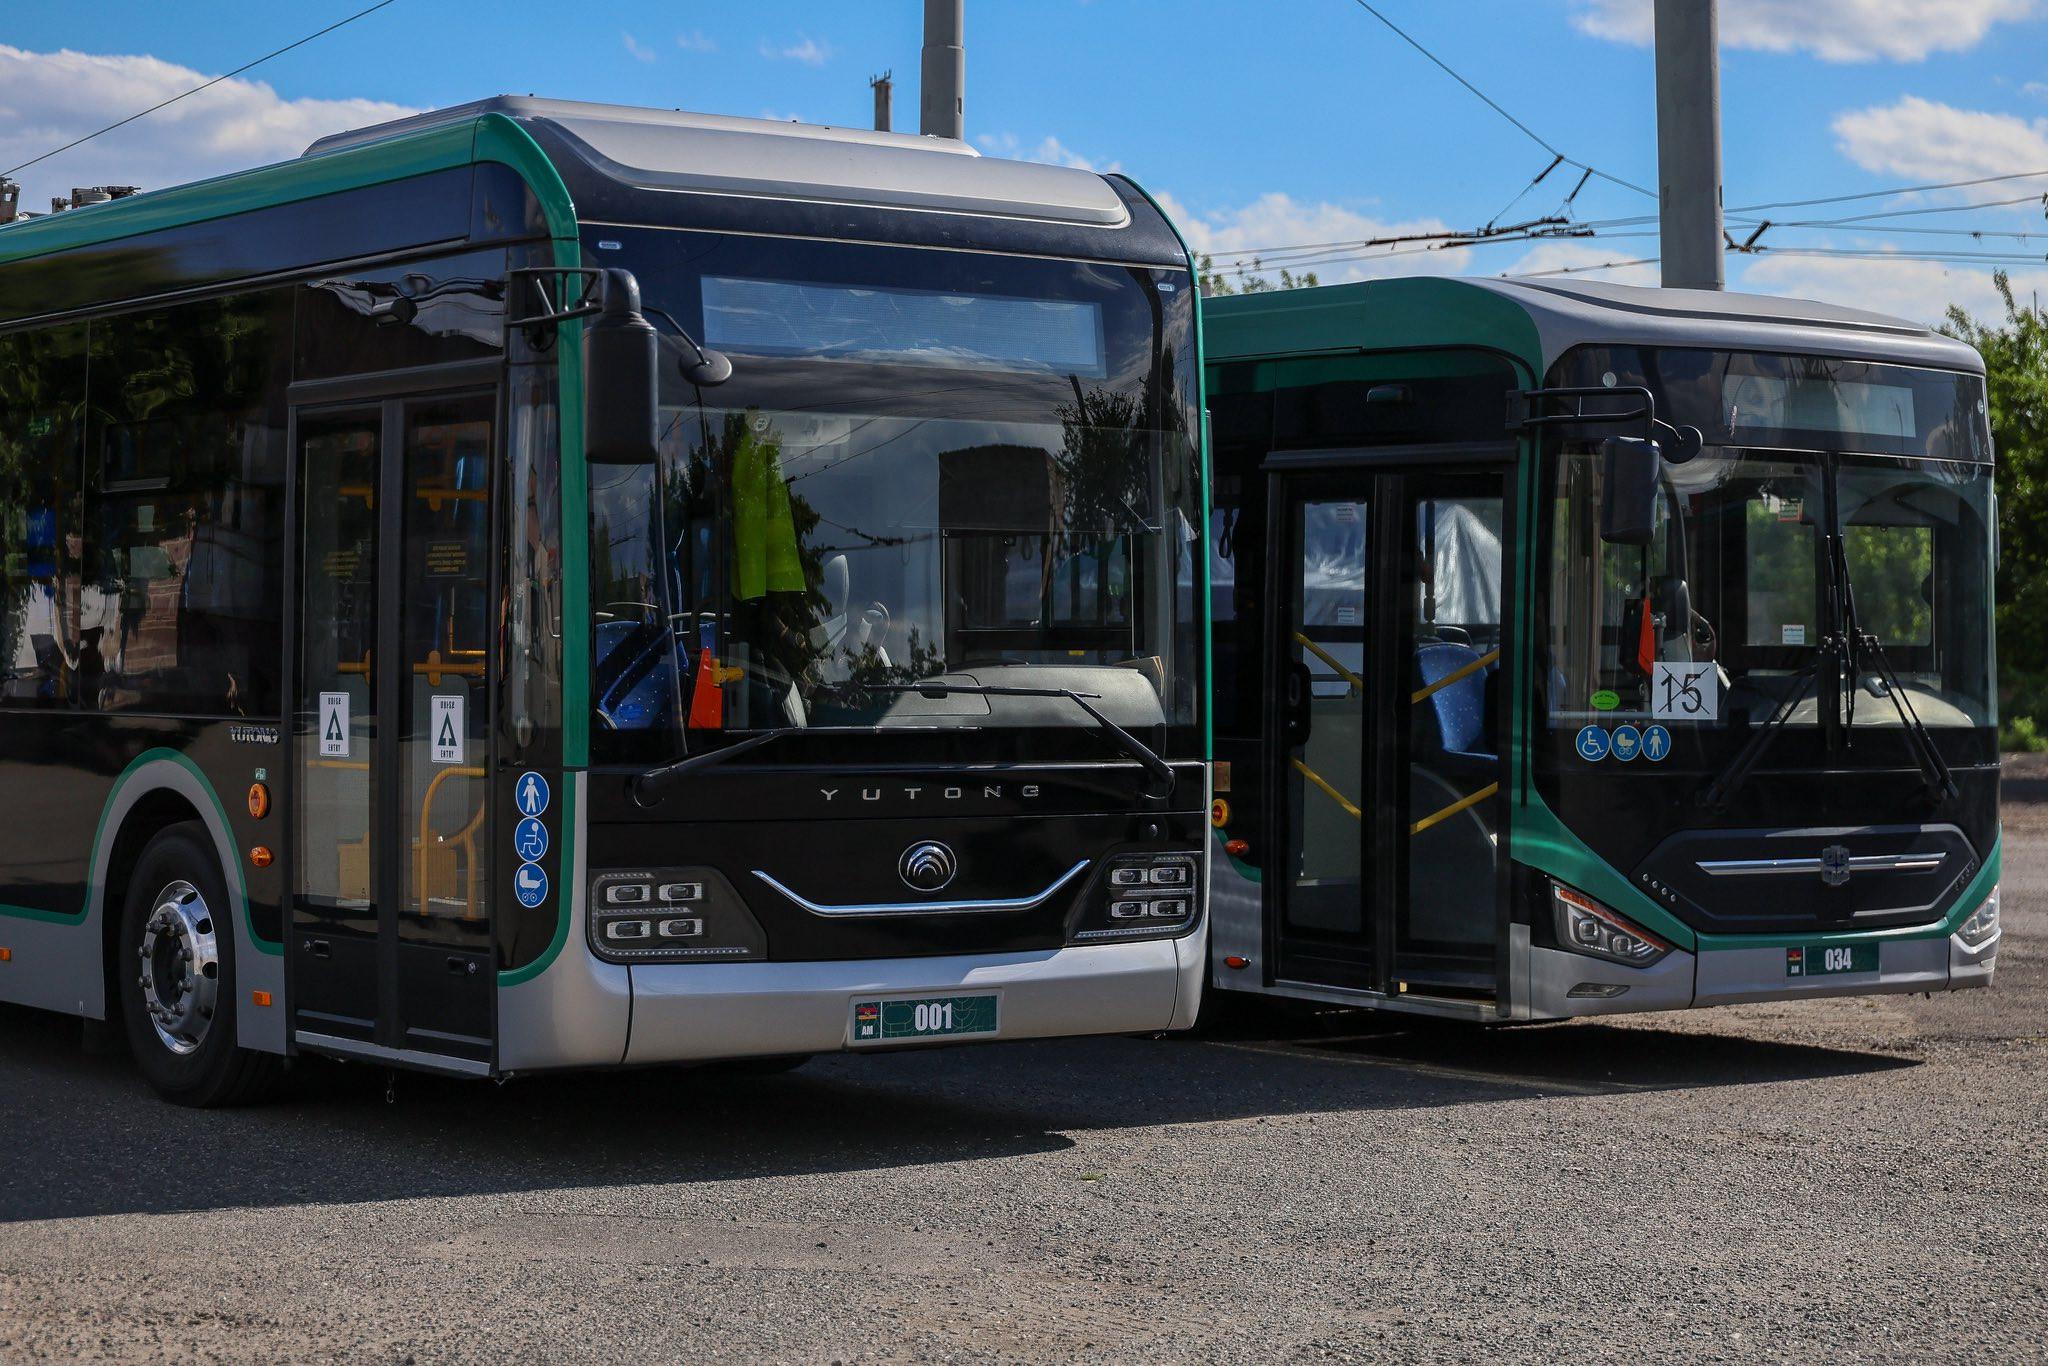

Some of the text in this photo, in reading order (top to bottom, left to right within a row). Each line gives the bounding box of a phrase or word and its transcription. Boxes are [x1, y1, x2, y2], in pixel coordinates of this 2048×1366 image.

[1661, 673, 1702, 713] 15
[440, 749, 454, 758] ENTRY
[820, 785, 1039, 801] YUTONG
[1825, 948, 1852, 971] 034
[914, 1002, 952, 1031] 001
[861, 1025, 874, 1036] AM
